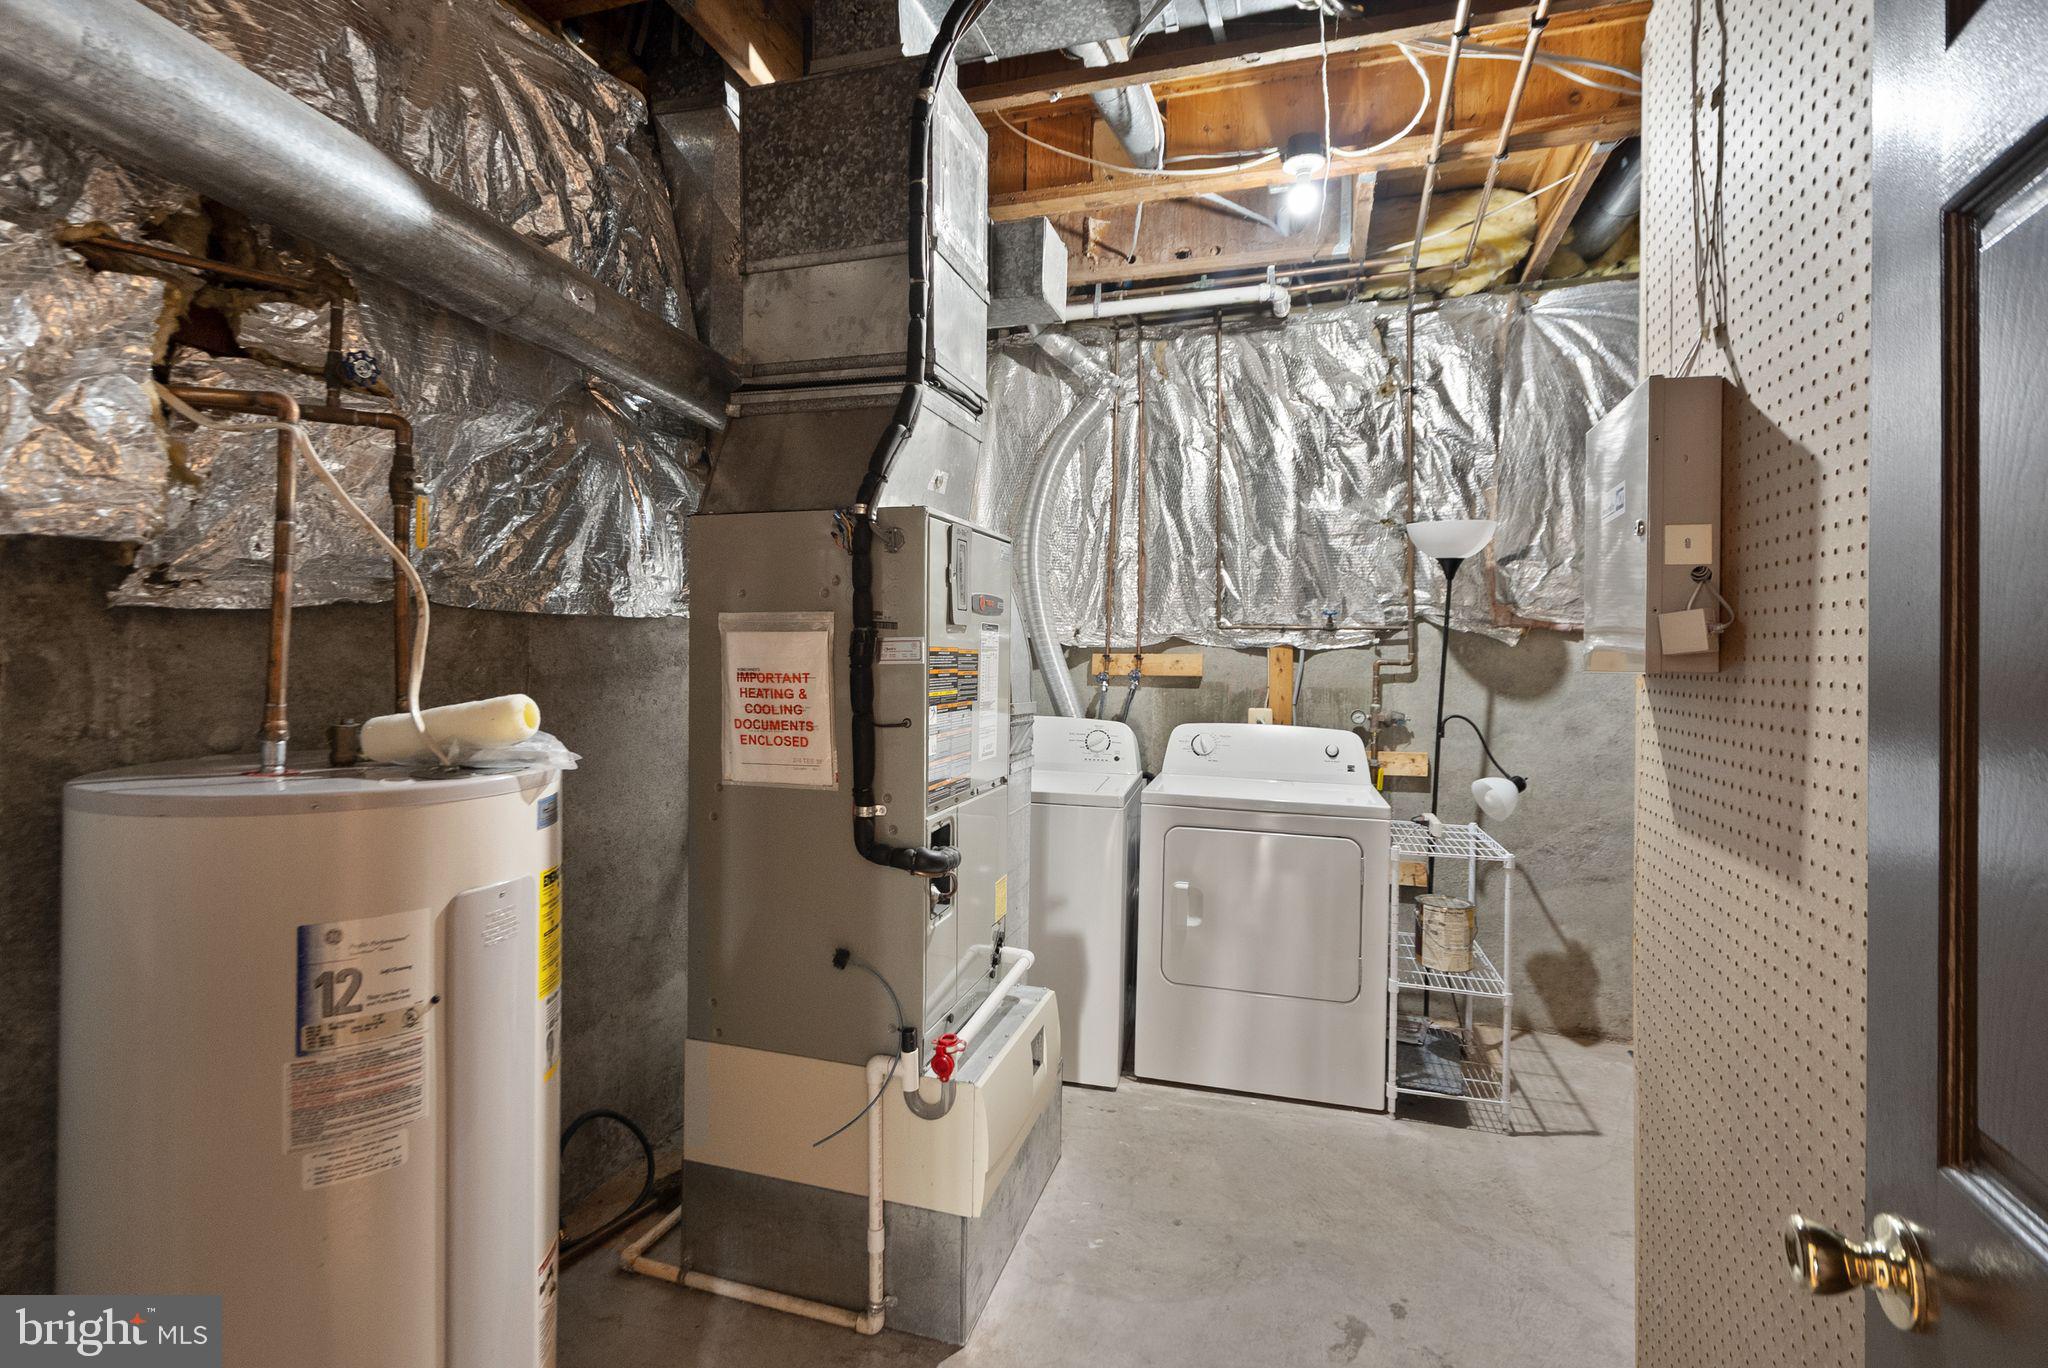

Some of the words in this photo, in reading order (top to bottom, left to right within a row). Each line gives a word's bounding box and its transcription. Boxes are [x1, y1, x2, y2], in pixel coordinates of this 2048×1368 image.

[737, 672, 810, 684] IMPORTANT
[740, 687, 794, 699] HEATING
[798, 688, 807, 699] &
[744, 703, 803, 715] COOLING
[734, 718, 815, 732] DOCUMENTS
[740, 734, 809, 748] ENCLOSED
[313, 967, 363, 1019] 12
